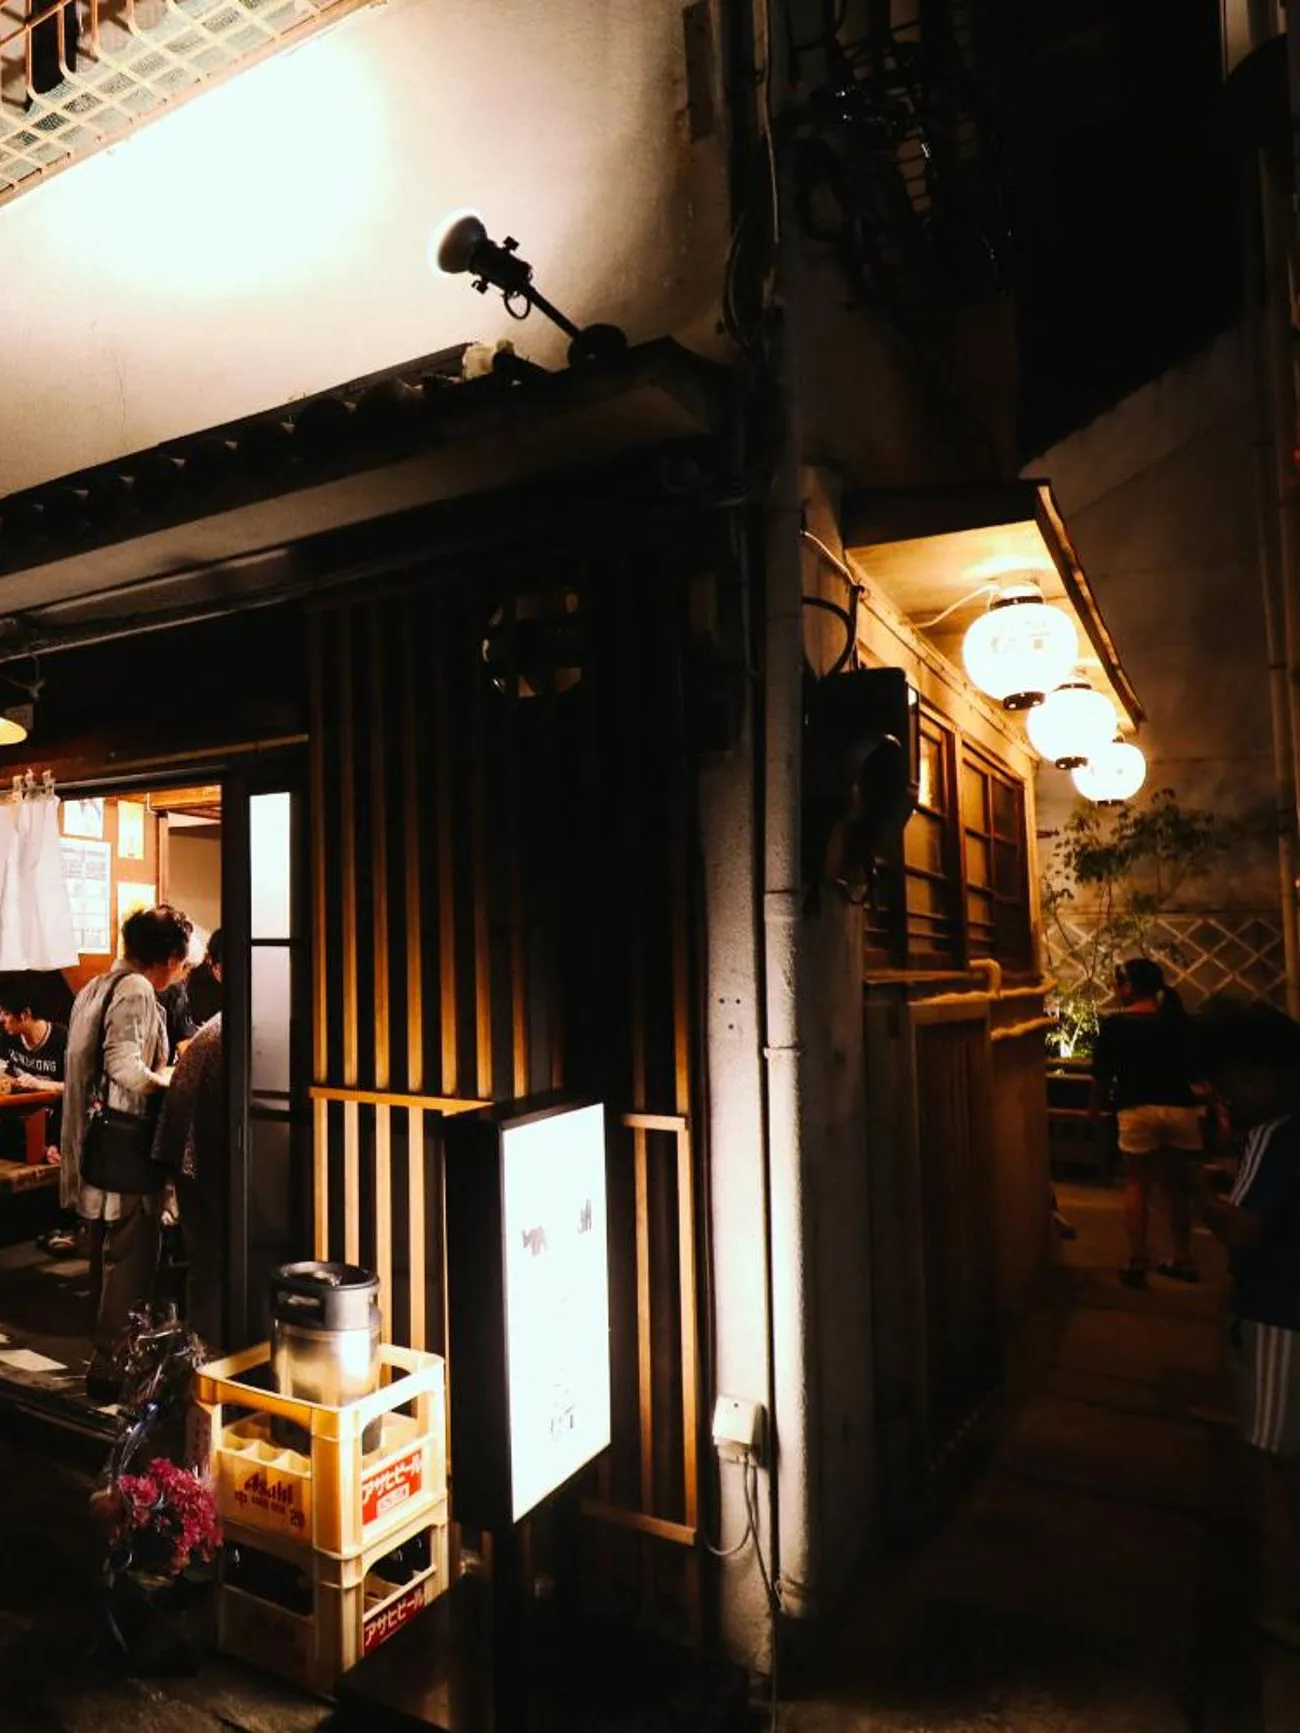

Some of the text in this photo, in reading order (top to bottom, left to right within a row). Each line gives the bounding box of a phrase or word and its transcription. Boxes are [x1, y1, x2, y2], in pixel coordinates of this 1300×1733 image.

[363, 1453, 422, 1505] アサヒビール
[365, 1587, 425, 1647] アサヒビール
